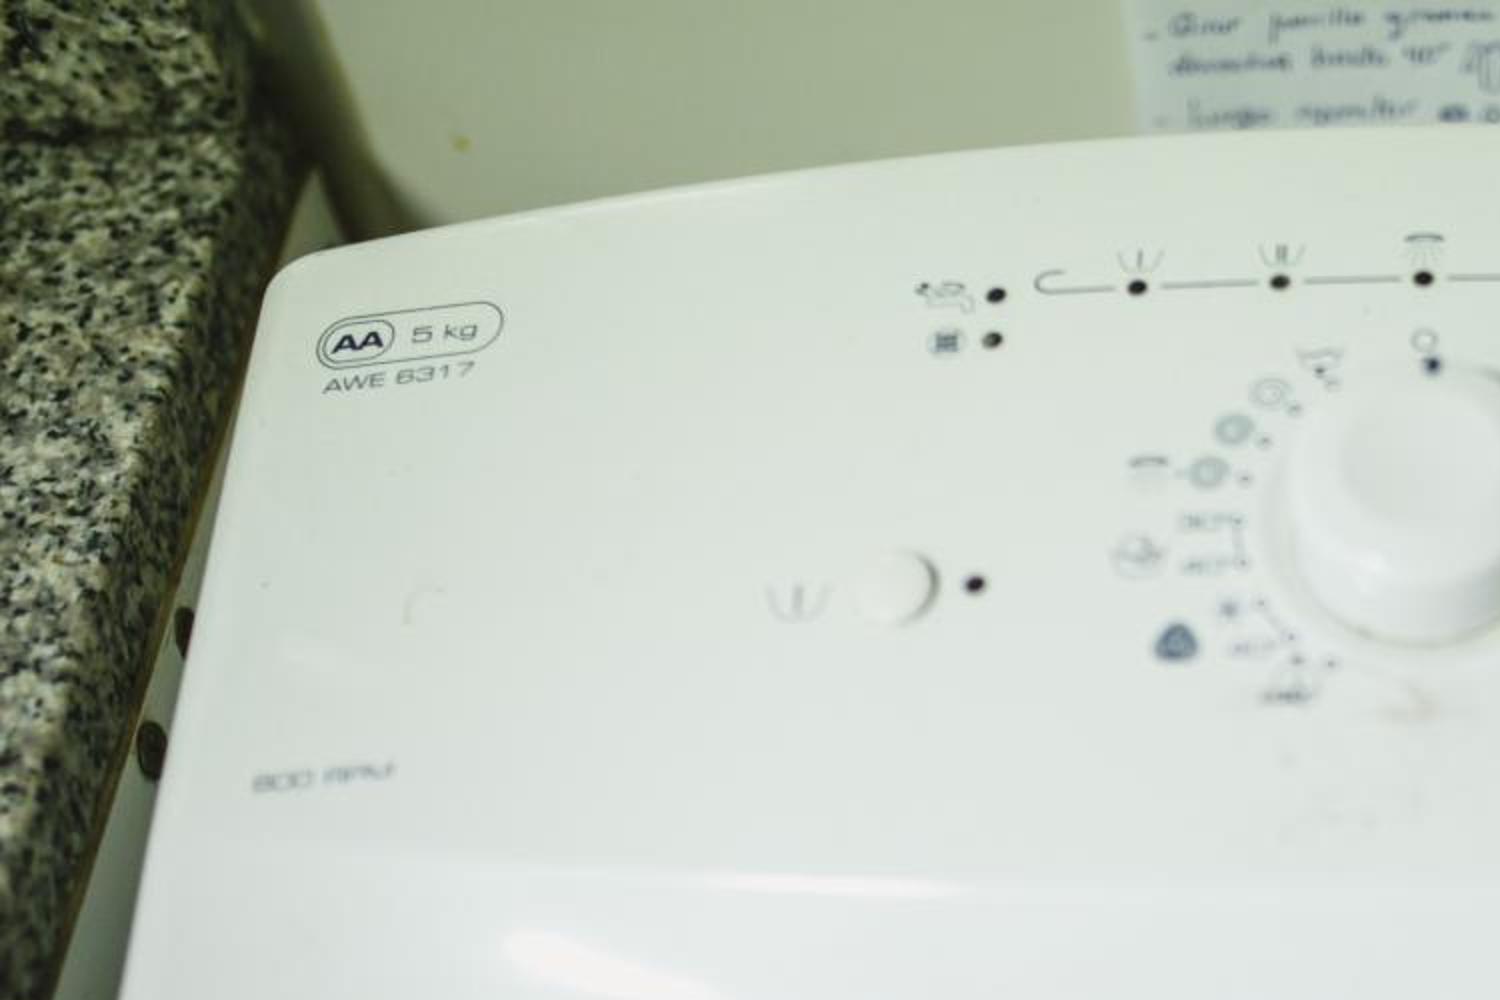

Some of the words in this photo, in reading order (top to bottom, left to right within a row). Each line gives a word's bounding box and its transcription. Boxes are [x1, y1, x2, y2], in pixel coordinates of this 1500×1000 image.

[331, 331, 383, 354] AA
[411, 325, 433, 344] 5
[443, 324, 478, 341] kg
[322, 371, 386, 394] AWE
